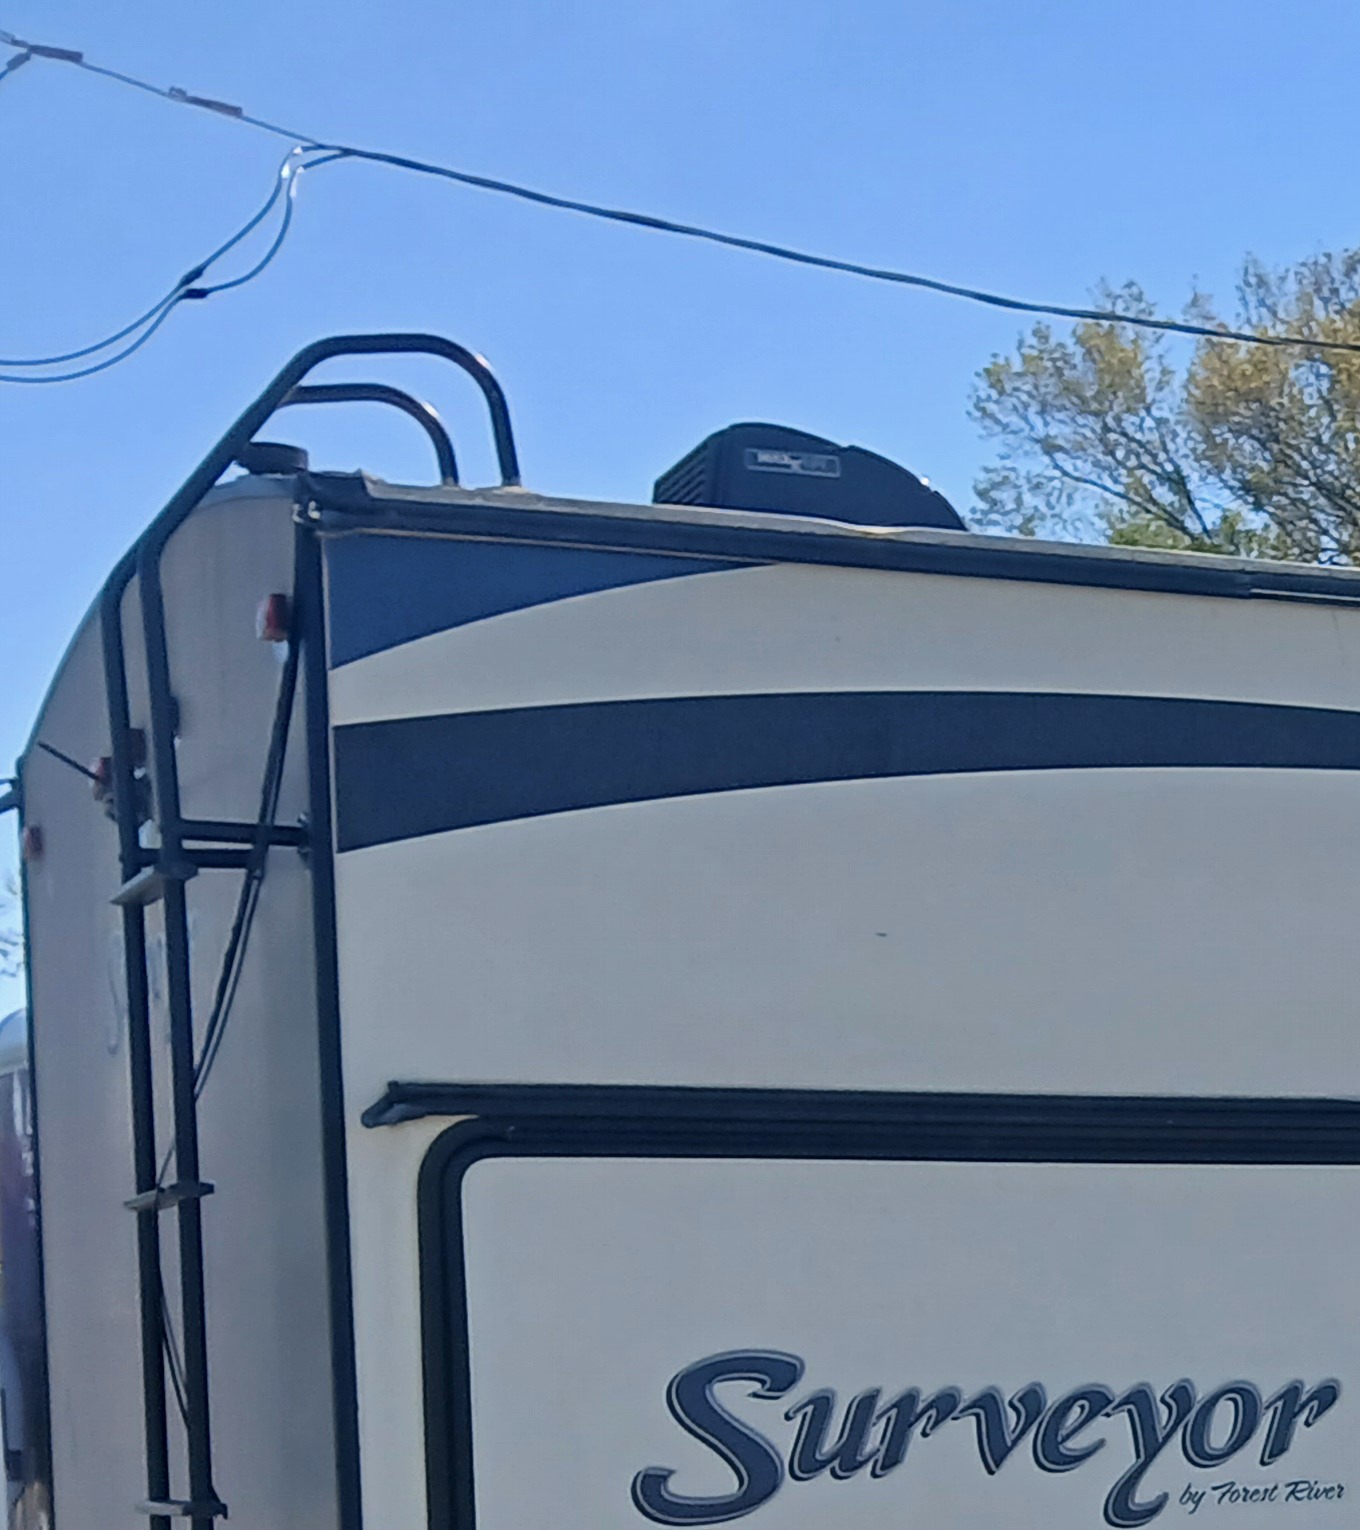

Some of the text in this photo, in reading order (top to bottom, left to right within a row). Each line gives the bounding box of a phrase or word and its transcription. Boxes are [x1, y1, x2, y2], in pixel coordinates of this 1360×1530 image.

[631, 1348, 1343, 1529] Surveyor
[1179, 1479, 1346, 1516] by Forest River
